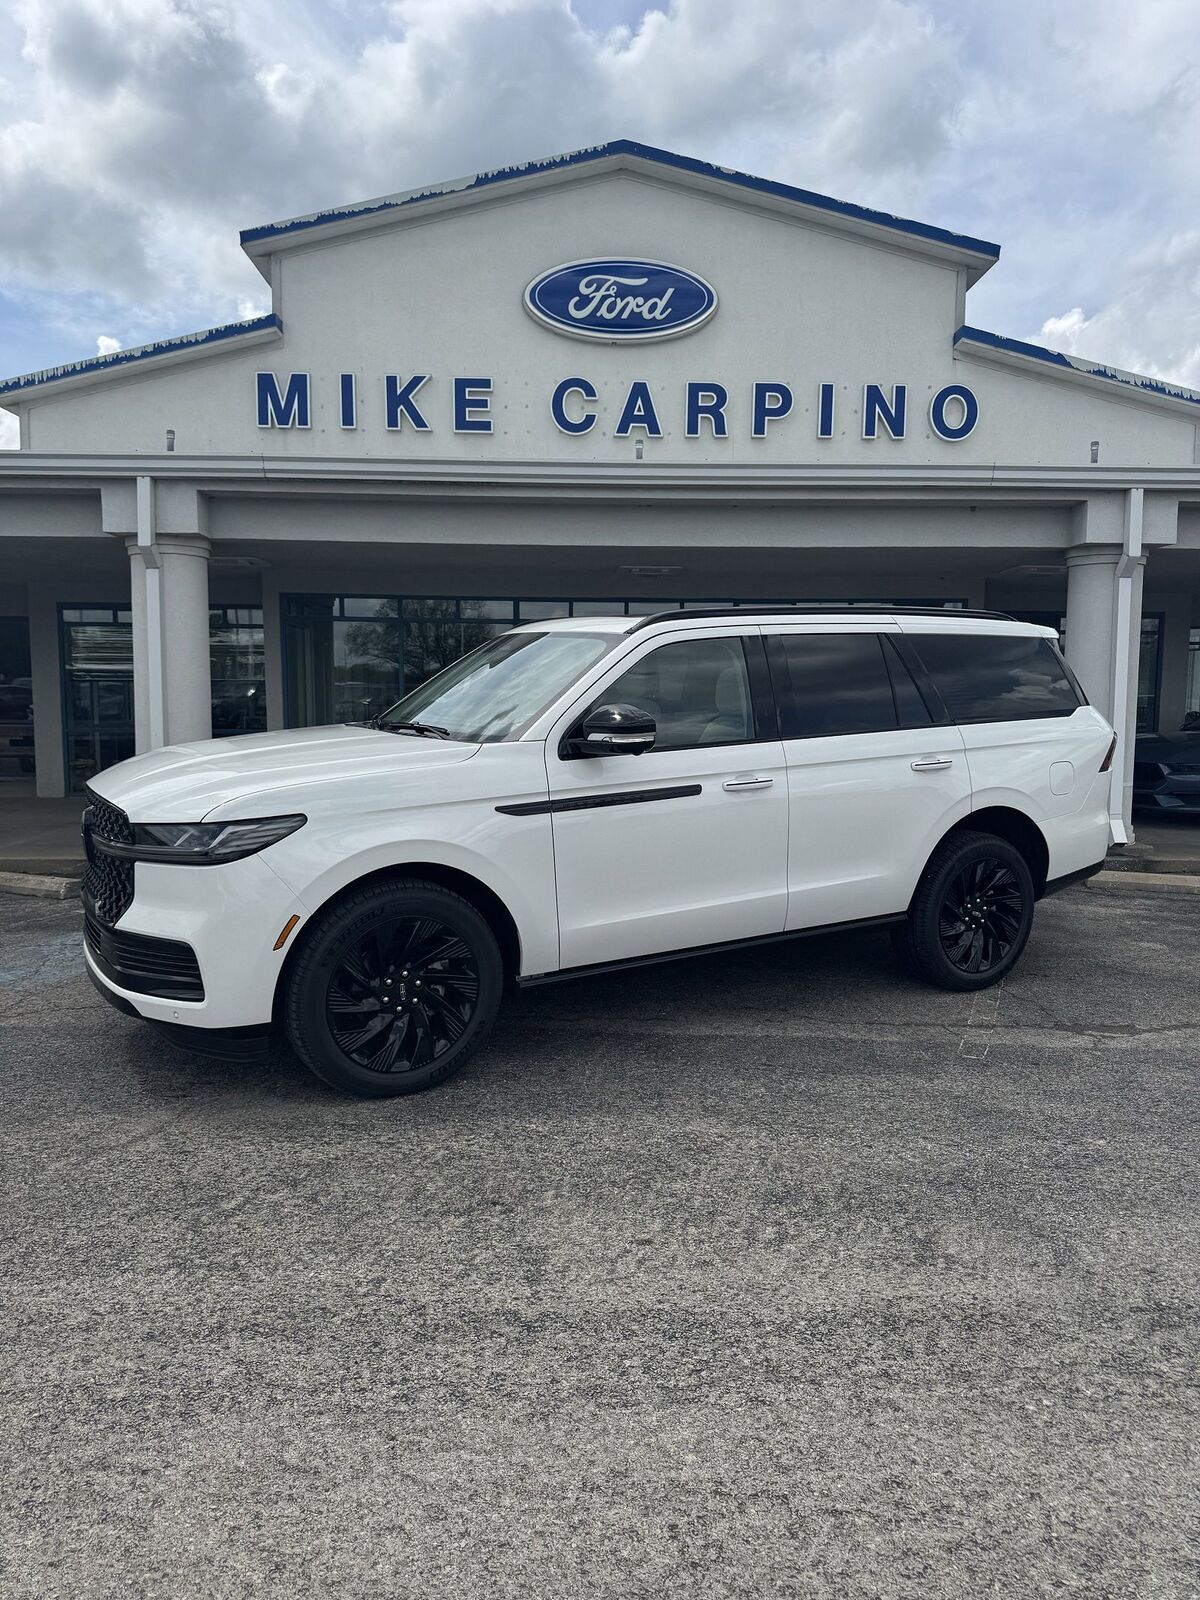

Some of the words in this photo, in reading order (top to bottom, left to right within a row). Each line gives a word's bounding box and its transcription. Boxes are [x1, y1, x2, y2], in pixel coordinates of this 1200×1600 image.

[567, 274, 675, 320] Ford
[256, 372, 493, 433] MIKE
[551, 377, 979, 440] CARPINO
